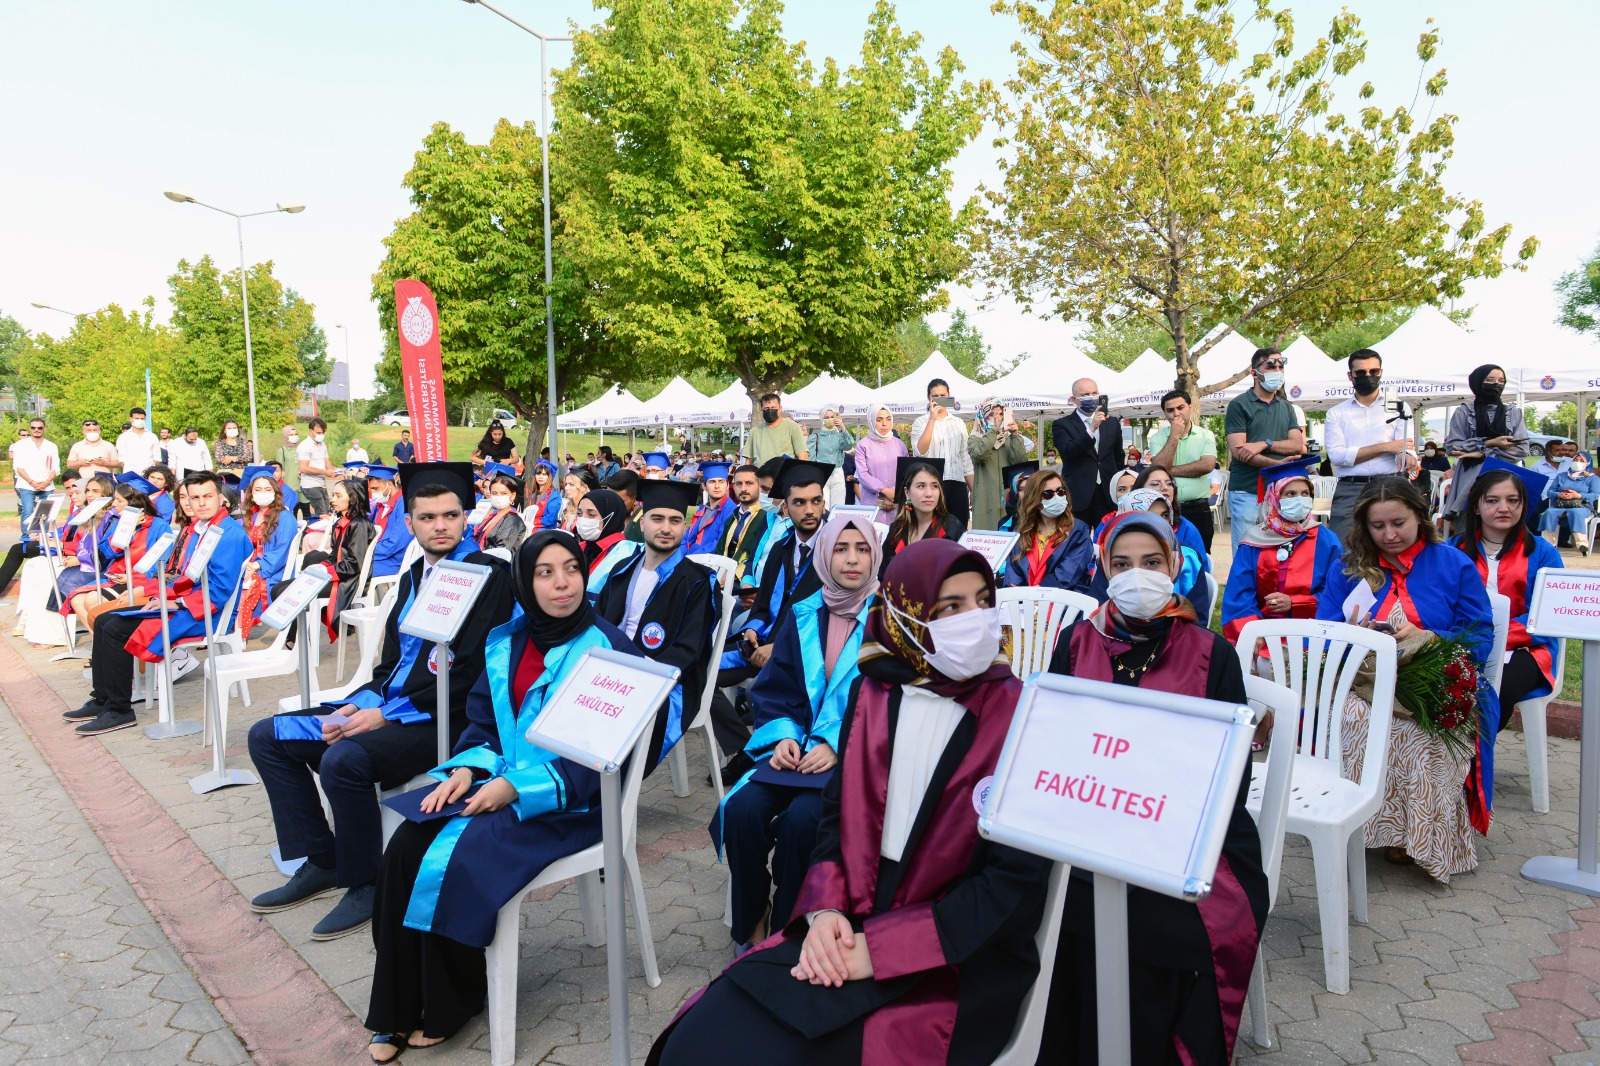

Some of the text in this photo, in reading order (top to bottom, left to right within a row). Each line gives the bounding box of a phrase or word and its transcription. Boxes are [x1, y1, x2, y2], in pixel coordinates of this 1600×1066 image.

[1398, 383, 1455, 393] İVERSİTESİ
[1546, 581, 1581, 590] SAĞLIK
[426, 603, 454, 616] FAKÜLTESİ
[591, 673, 635, 697] İLÂHİYAT
[574, 694, 625, 719] FAKÜLTESİ
[1092, 732, 1130, 759] TIP
[1034, 769, 1168, 823] FAKÜLTESİ
